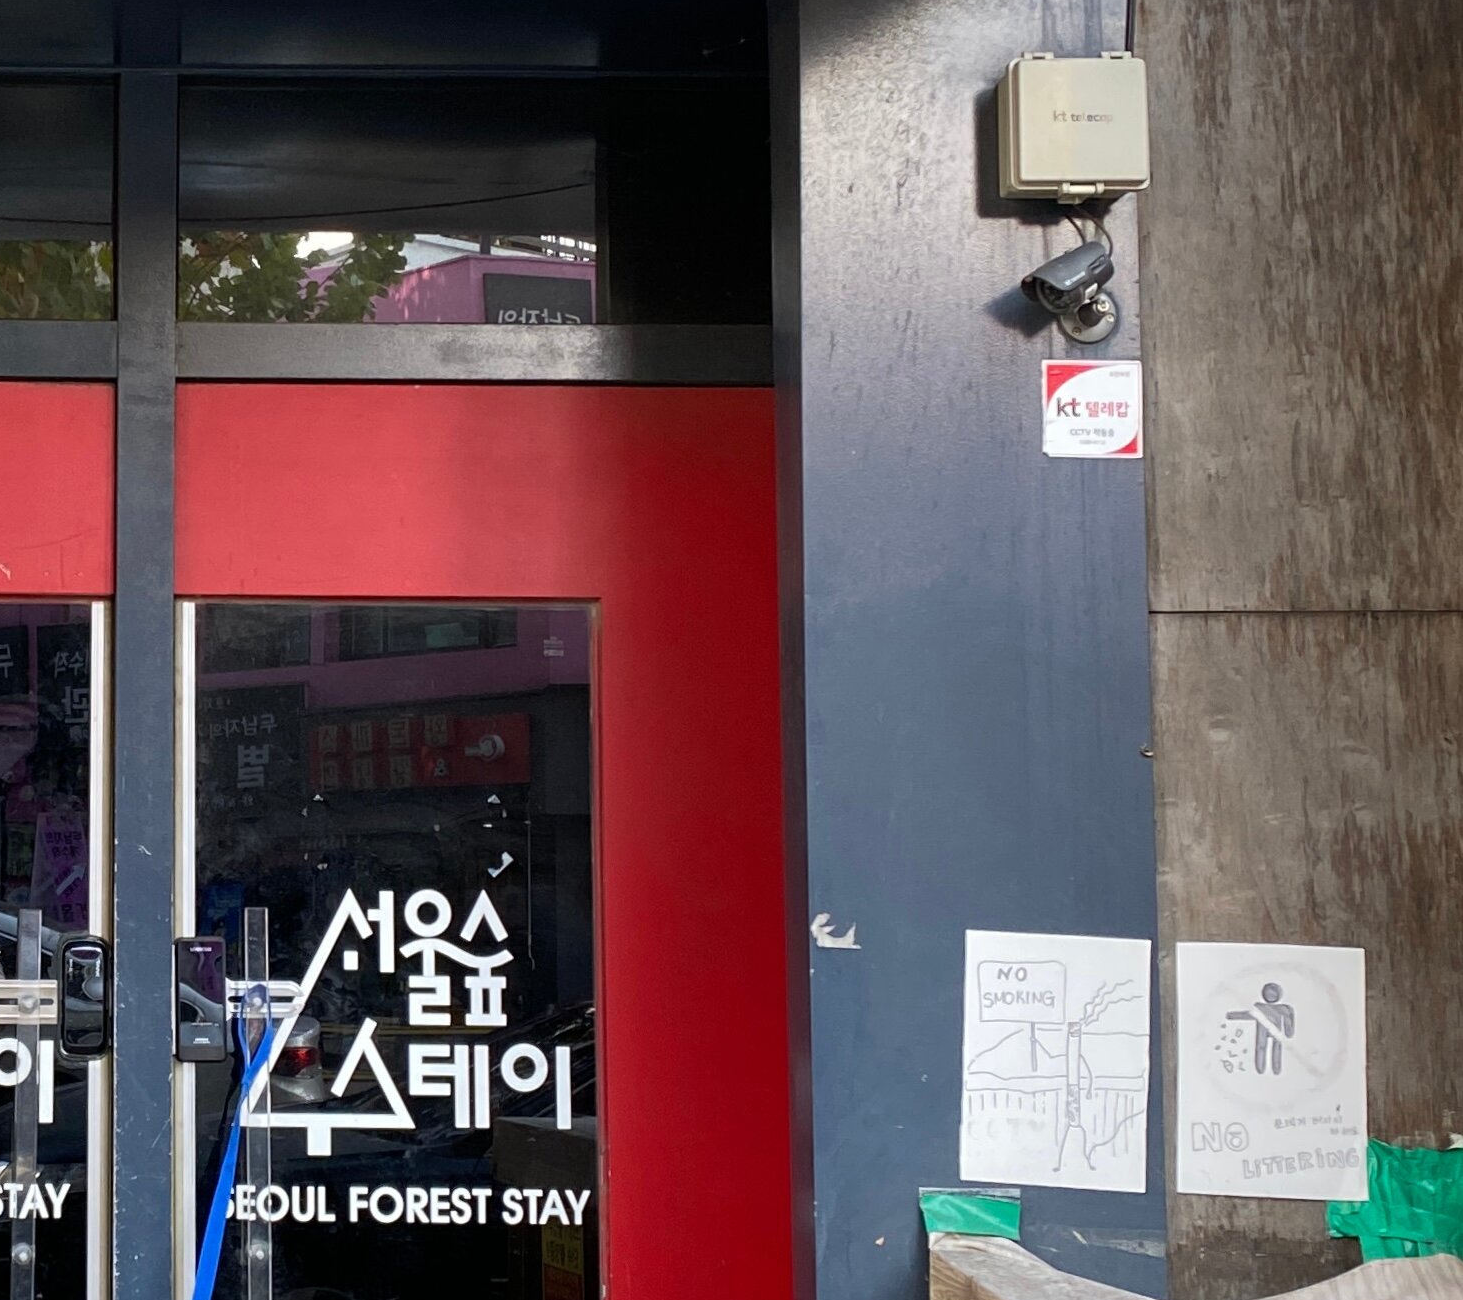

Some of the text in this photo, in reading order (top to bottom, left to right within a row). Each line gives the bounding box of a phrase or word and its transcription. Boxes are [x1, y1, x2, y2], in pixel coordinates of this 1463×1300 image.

[1056, 397, 1081, 418] kt
[997, 966, 1028, 982] NO
[983, 989, 1055, 1008] SMOKING
[1191, 1121, 1250, 1153] NO
[349, 1186, 492, 1224] FOREST
[502, 1188, 591, 1226] STAY
